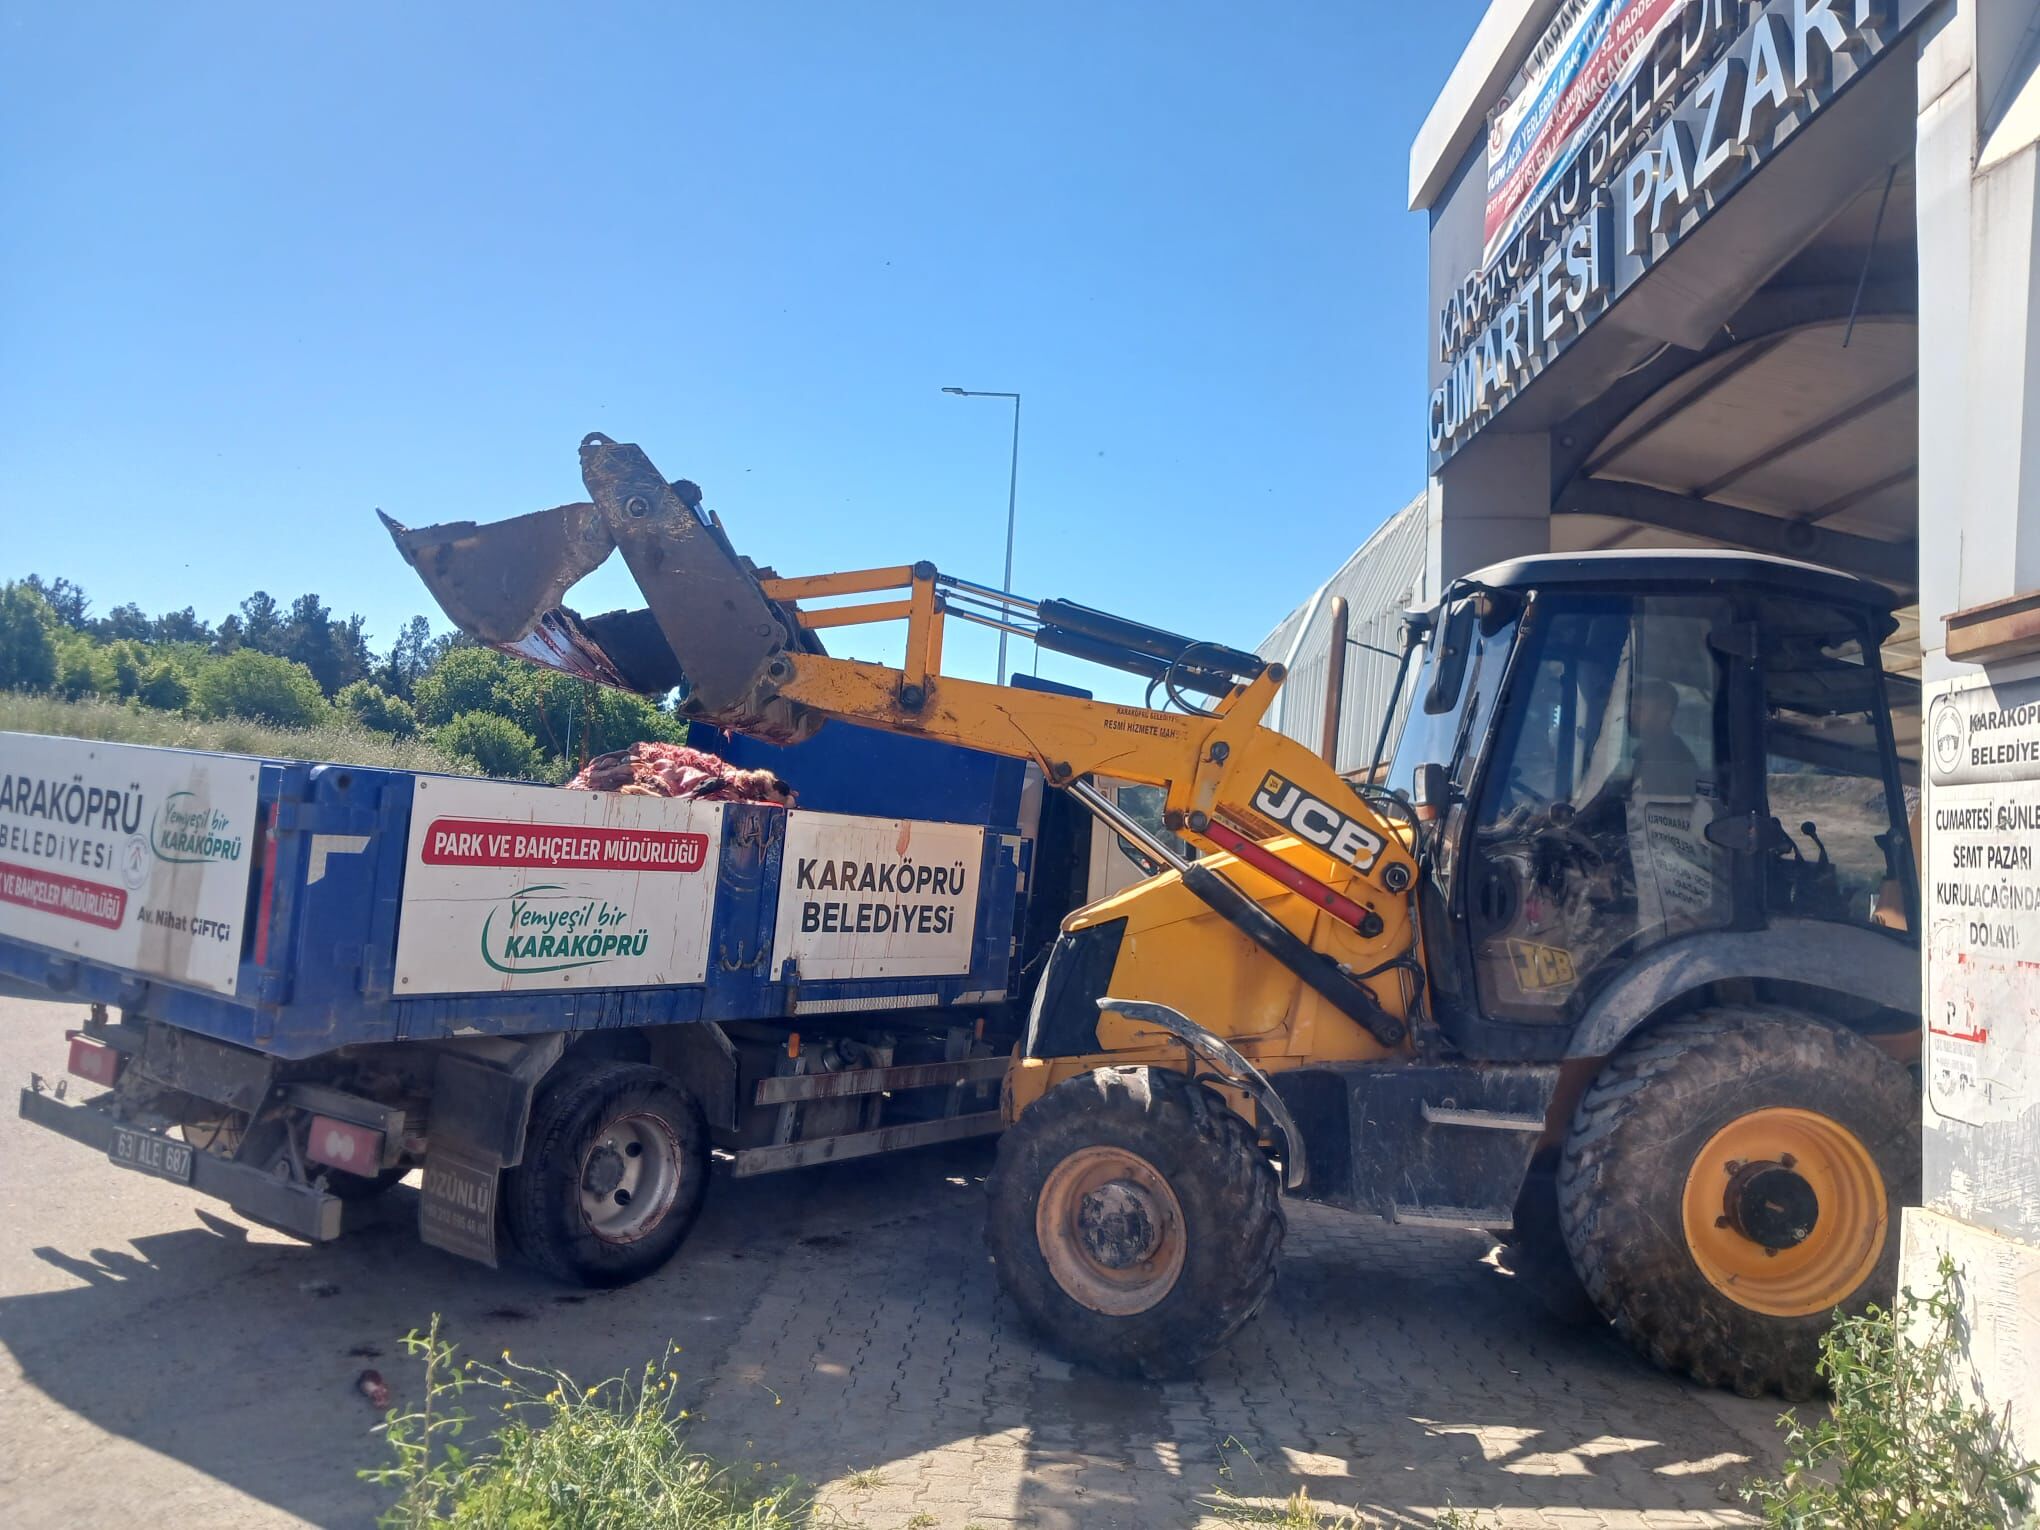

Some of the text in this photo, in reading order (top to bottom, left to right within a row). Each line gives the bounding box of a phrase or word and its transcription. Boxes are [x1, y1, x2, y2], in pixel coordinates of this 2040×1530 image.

[1427, 0, 1870, 452] CUMARTESİ PAZAR
[1104, 719, 1126, 731] RESMİ
[1127, 723, 1159, 736] HİZMETE
[1970, 703, 2040, 733] KARAKÖP
[165, 803, 229, 833] Yemyeşil bir
[1256, 786, 1381, 870] JCB
[1936, 801, 1992, 831] CUMARTESİ
[160, 830, 242, 861] KARAKÖPRÜ
[434, 832, 699, 865] PARK VE BAHÇELER MÜDÜRLÜĞÜ
[1953, 845, 2032, 871] SEMT PAZARI
[797, 856, 966, 896] KARAKÖPRÜ
[3, 874, 121, 921] VE BAHÇELER MÜDÜRLÜĞÜ
[137, 906, 231, 942] Av. Nihat ÇİFTÇİ
[510, 900, 628, 934] Yemyeşil bir
[801, 901, 955, 934] BELEDİYESİ
[504, 929, 649, 958] KARAKÖPRÜ
[118, 1133, 191, 1175] 63 ALE 687
